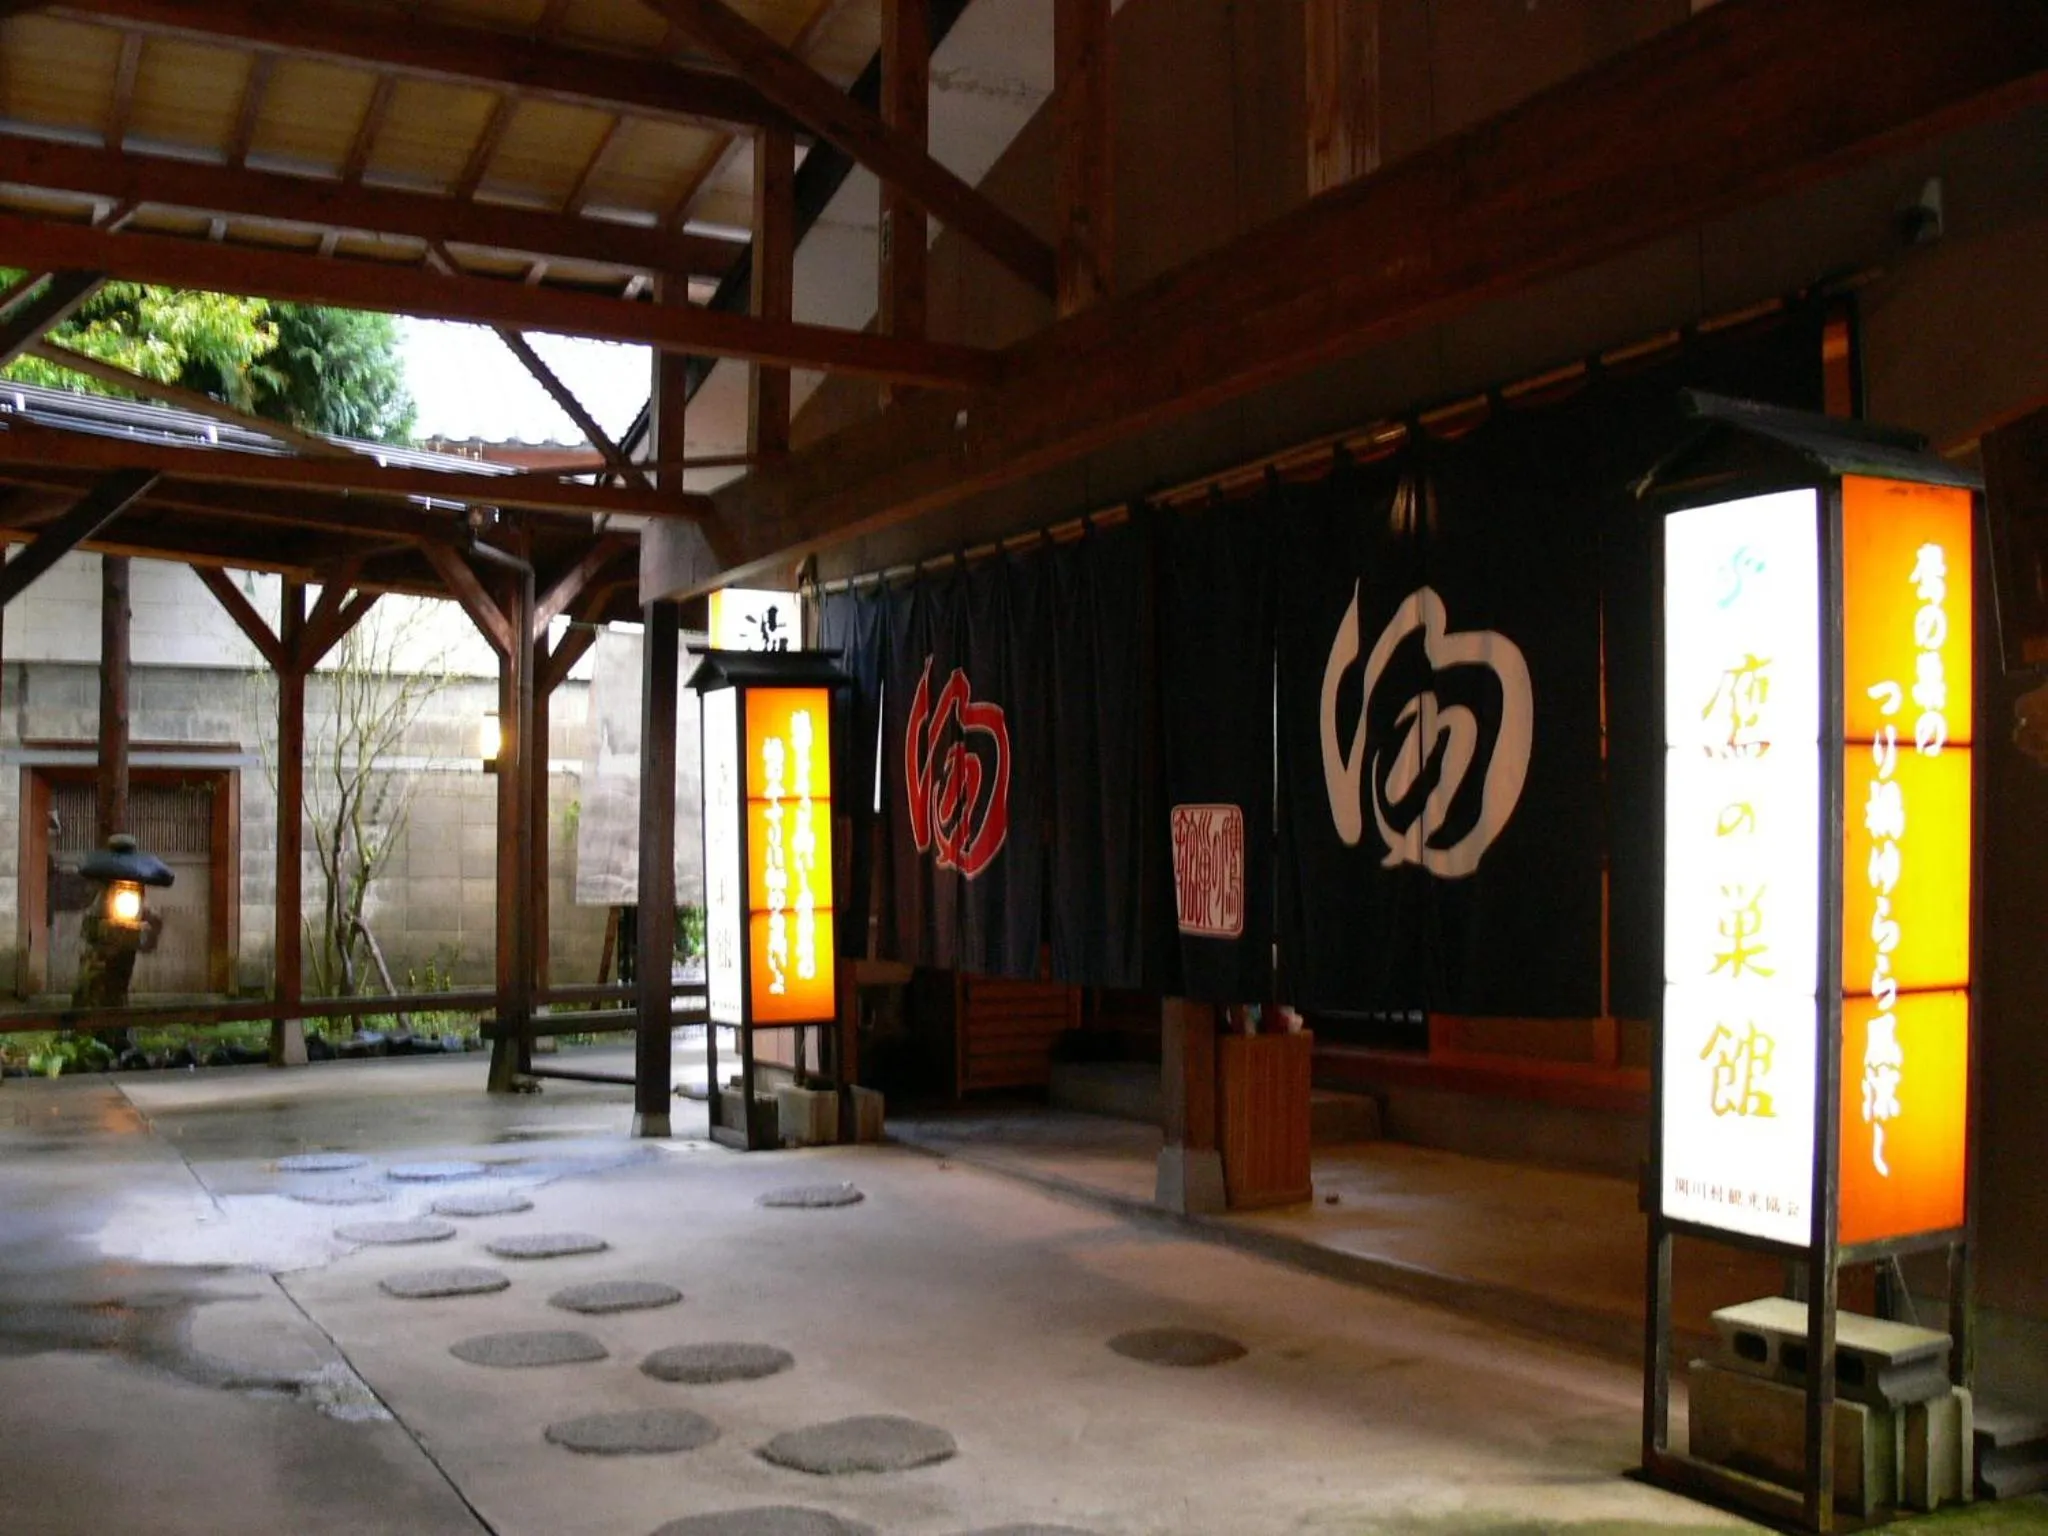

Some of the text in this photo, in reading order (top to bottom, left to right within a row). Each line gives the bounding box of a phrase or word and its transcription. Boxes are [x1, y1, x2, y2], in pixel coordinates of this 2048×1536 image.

[904, 653, 1011, 881] ゆ
[1320, 576, 1534, 881] ゆ
[1700, 652, 1778, 1119] 鷹の巣館
